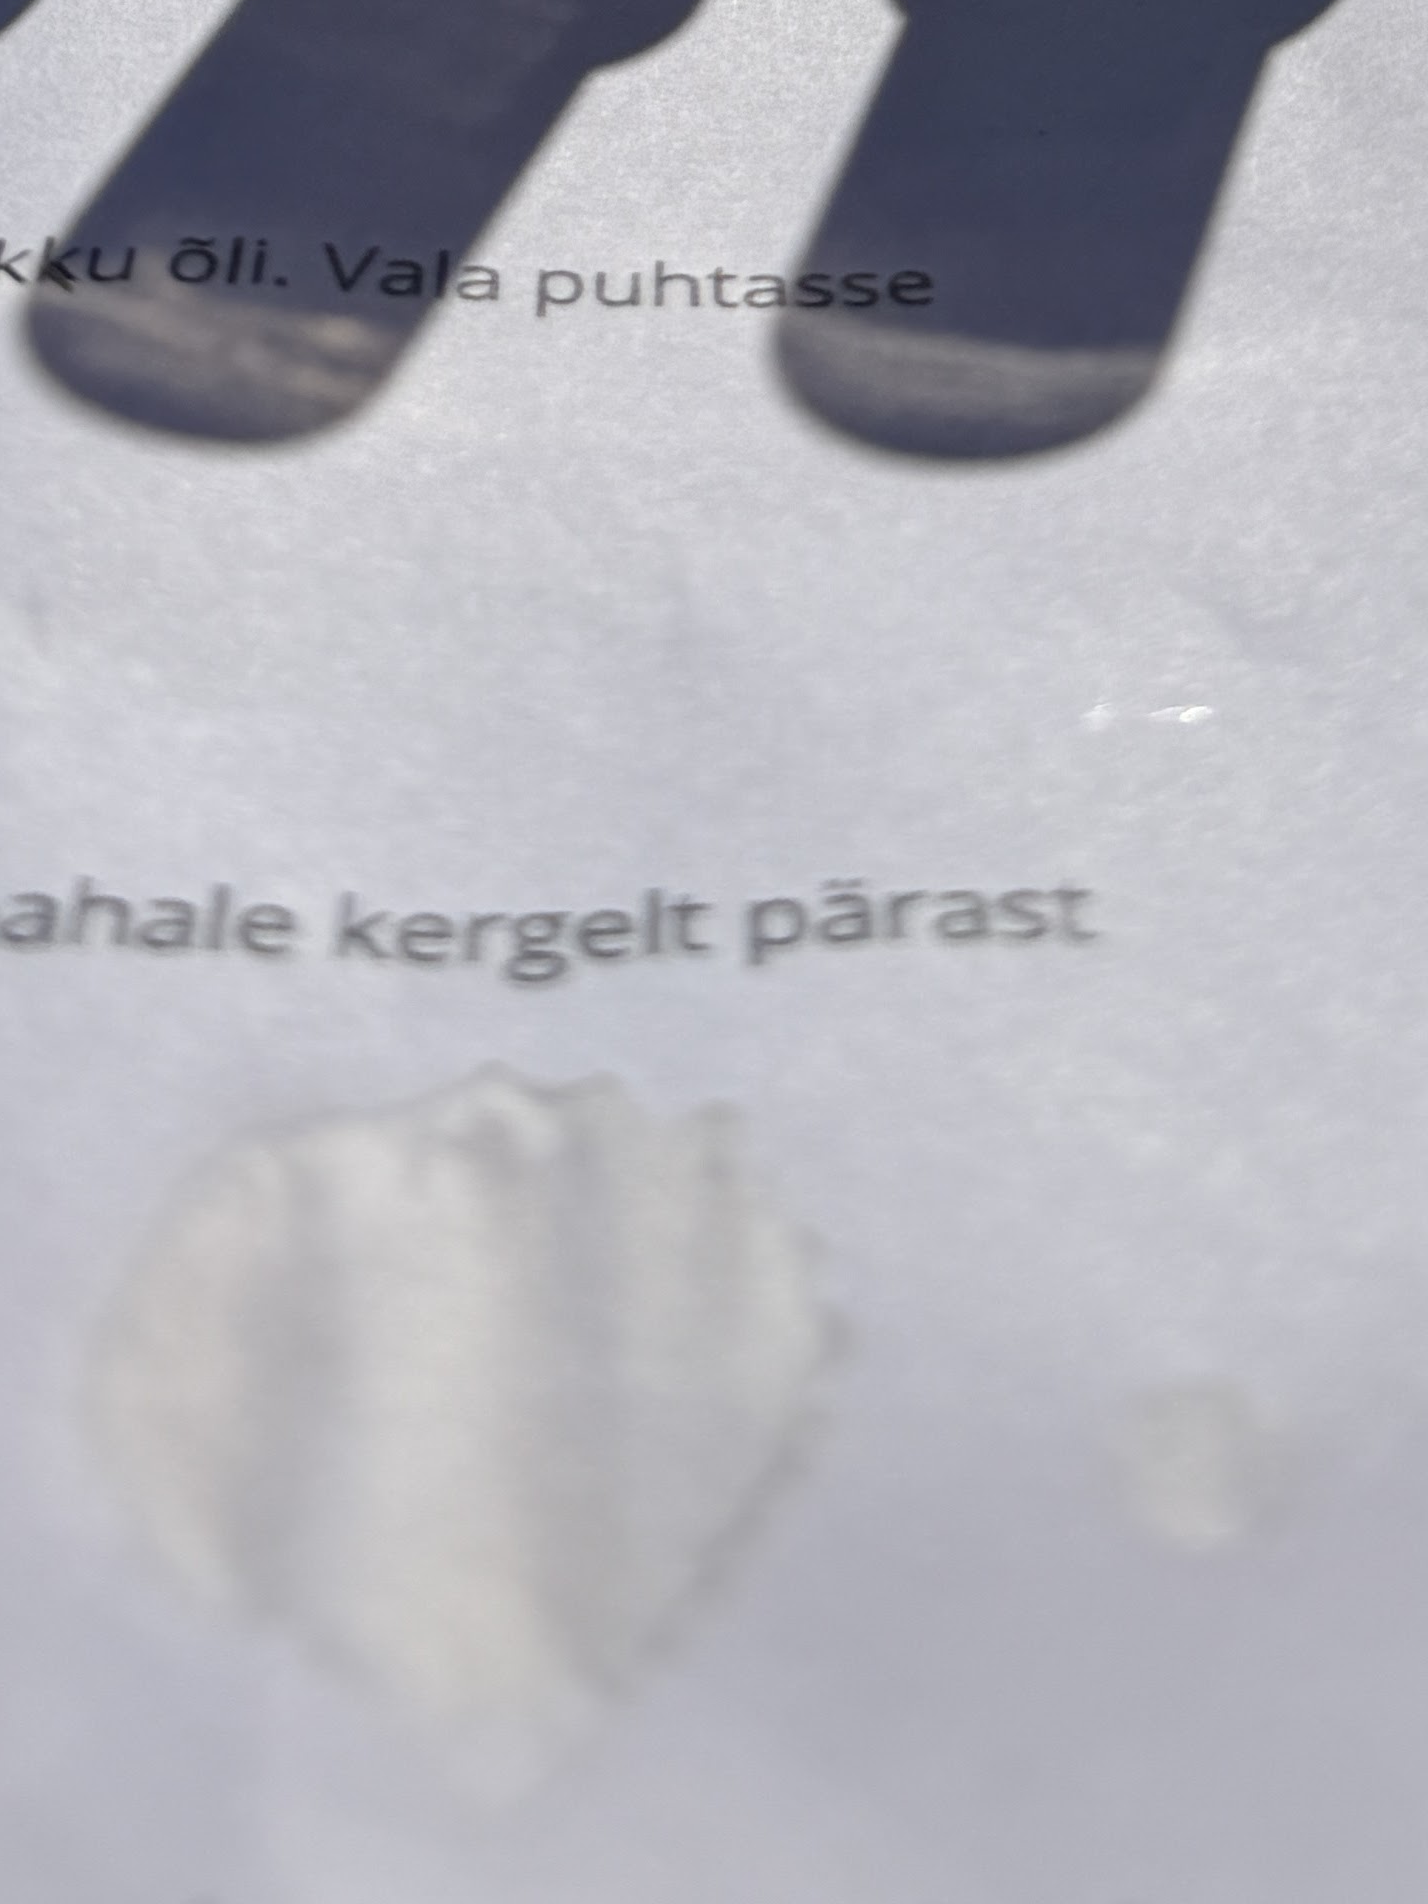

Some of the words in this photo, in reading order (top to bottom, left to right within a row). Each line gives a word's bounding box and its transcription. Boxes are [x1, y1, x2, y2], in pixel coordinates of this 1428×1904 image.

[168, 235, 290, 290] õli.
[323, 240, 503, 304] Vala
[535, 260, 937, 318] puhtasse
[332, 886, 717, 989] kergelt
[743, 877, 1102, 970] pärast
